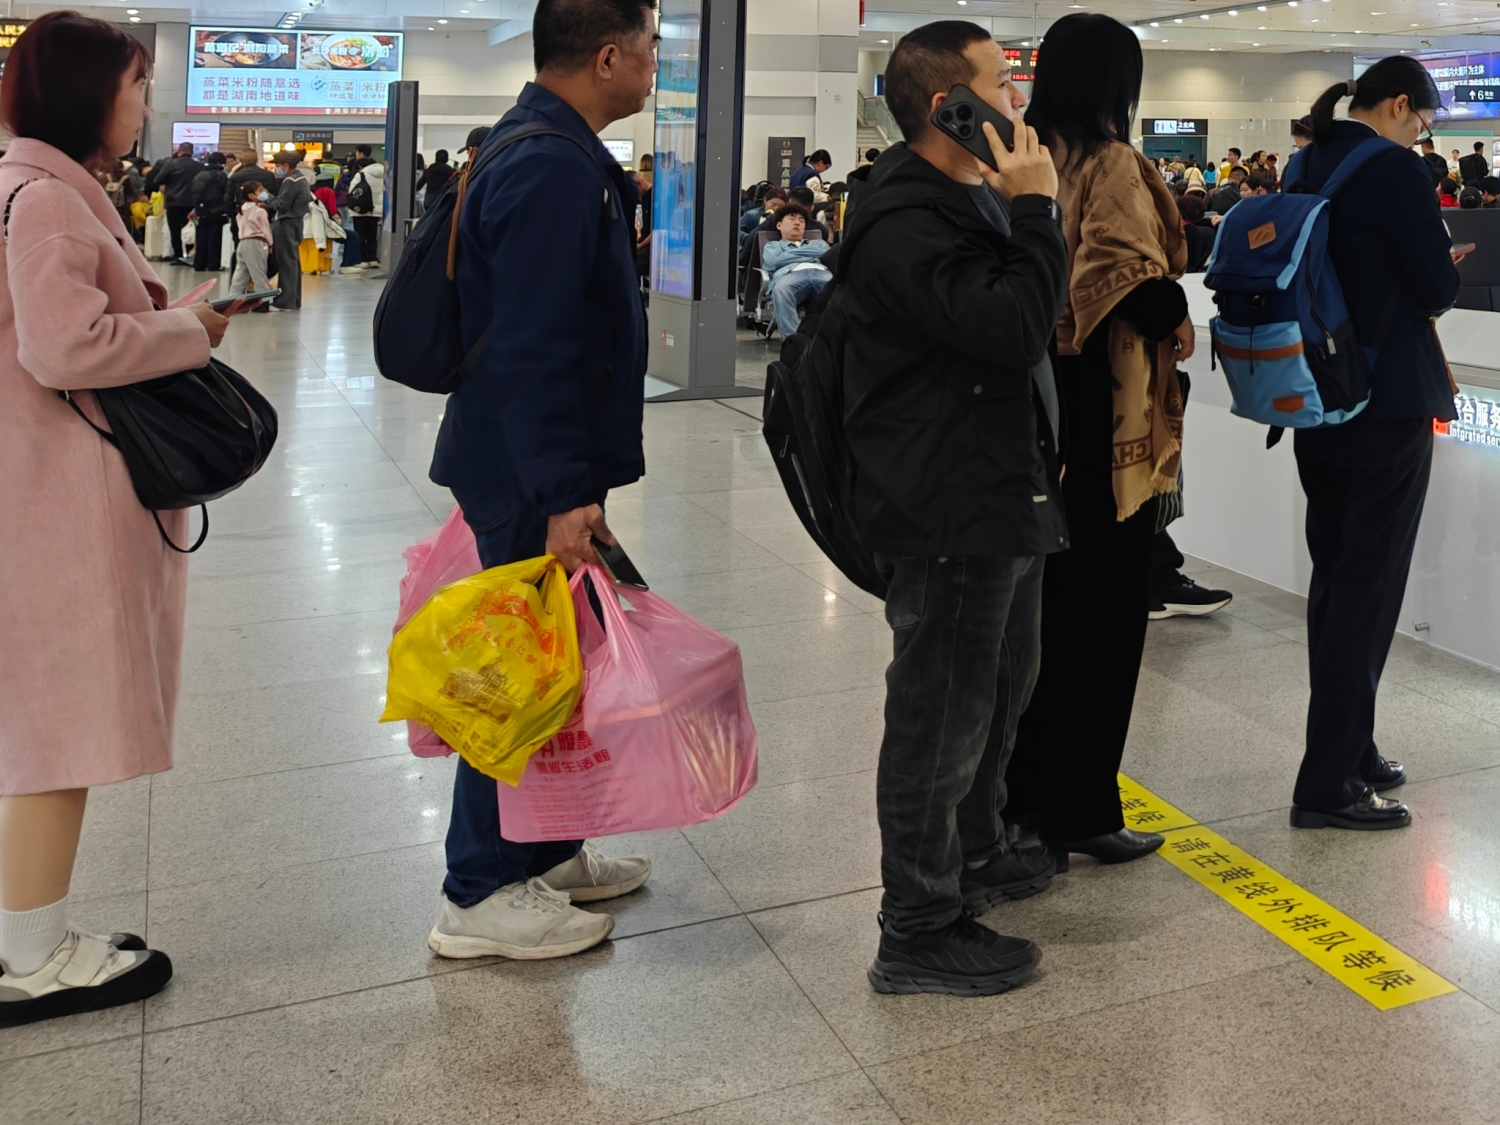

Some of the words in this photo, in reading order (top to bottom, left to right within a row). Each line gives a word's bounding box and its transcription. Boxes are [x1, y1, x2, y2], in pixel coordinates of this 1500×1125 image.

[203, 77, 301, 88] 蒸菜米粉随意选
[202, 90, 301, 101] 都是湖南地道味
[1477, 89, 1484, 101] 6
[1170, 836, 1416, 993] 请在黄线外排队等候
